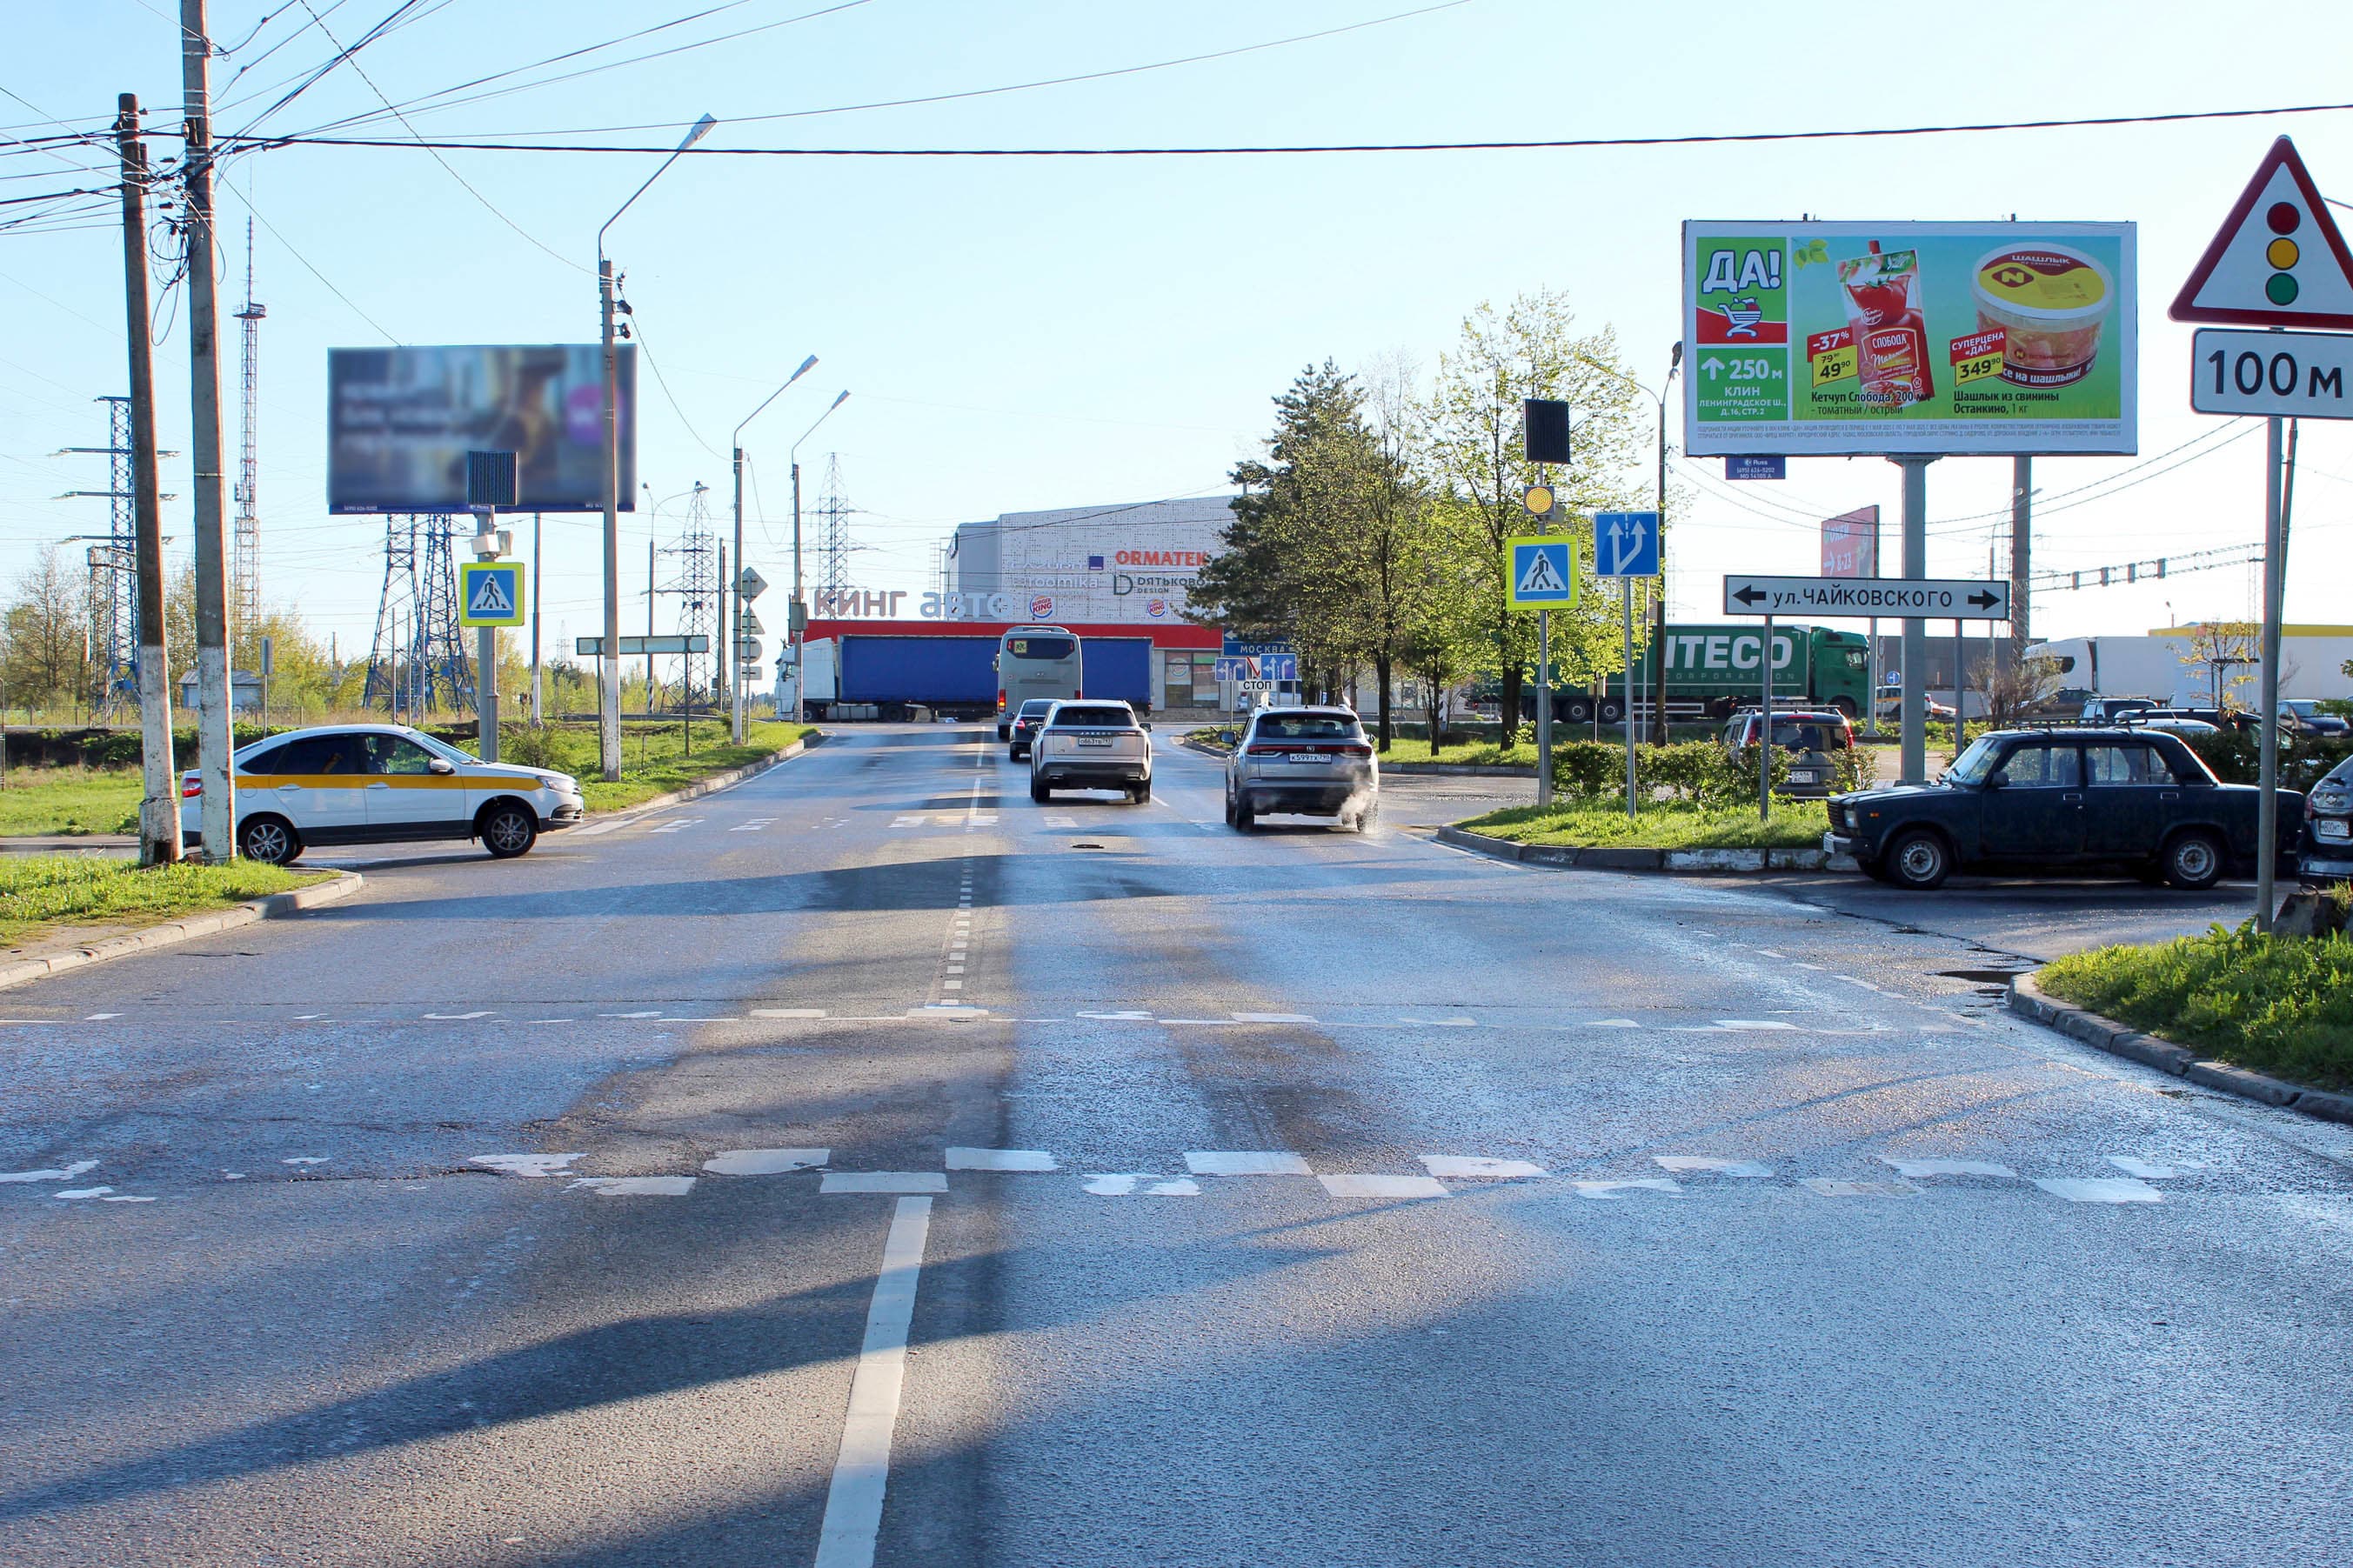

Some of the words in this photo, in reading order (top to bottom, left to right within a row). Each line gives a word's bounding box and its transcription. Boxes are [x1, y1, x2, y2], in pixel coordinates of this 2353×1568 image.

[2011, 255, 2070, 264] ШАШЛЫК
[1702, 249, 1781, 294] ДА!
[1812, 330, 1849, 350] -37%
[1872, 333, 1907, 349] СЛОБОДА
[1951, 332, 2004, 350] СУПЕРЦЕНА
[1729, 359, 1768, 379] 250
[1772, 370, 1782, 379] м
[2207, 350, 2298, 397] 100
[2015, 371, 2028, 382] на
[1724, 386, 1761, 397] КЛИН
[1811, 391, 1846, 404] Кетчуп
[1848, 391, 1894, 404] Слобода,
[1896, 392, 1914, 402] 200
[1954, 391, 1999, 402] Шашлык
[2002, 393, 2013, 402] из
[2015, 393, 2059, 402] свинины
[1817, 405, 1862, 415] томатный
[1870, 404, 1903, 417] острый
[1954, 404, 2009, 415] Останкино,
[2018, 404, 2029, 414] кг
[1115, 550, 1208, 567] ORMATEK
[1033, 602, 1053, 613] KING
[1147, 603, 1165, 613] KING
[1240, 645, 1285, 654] МОСКВА
[1243, 681, 1272, 690] СТОП
